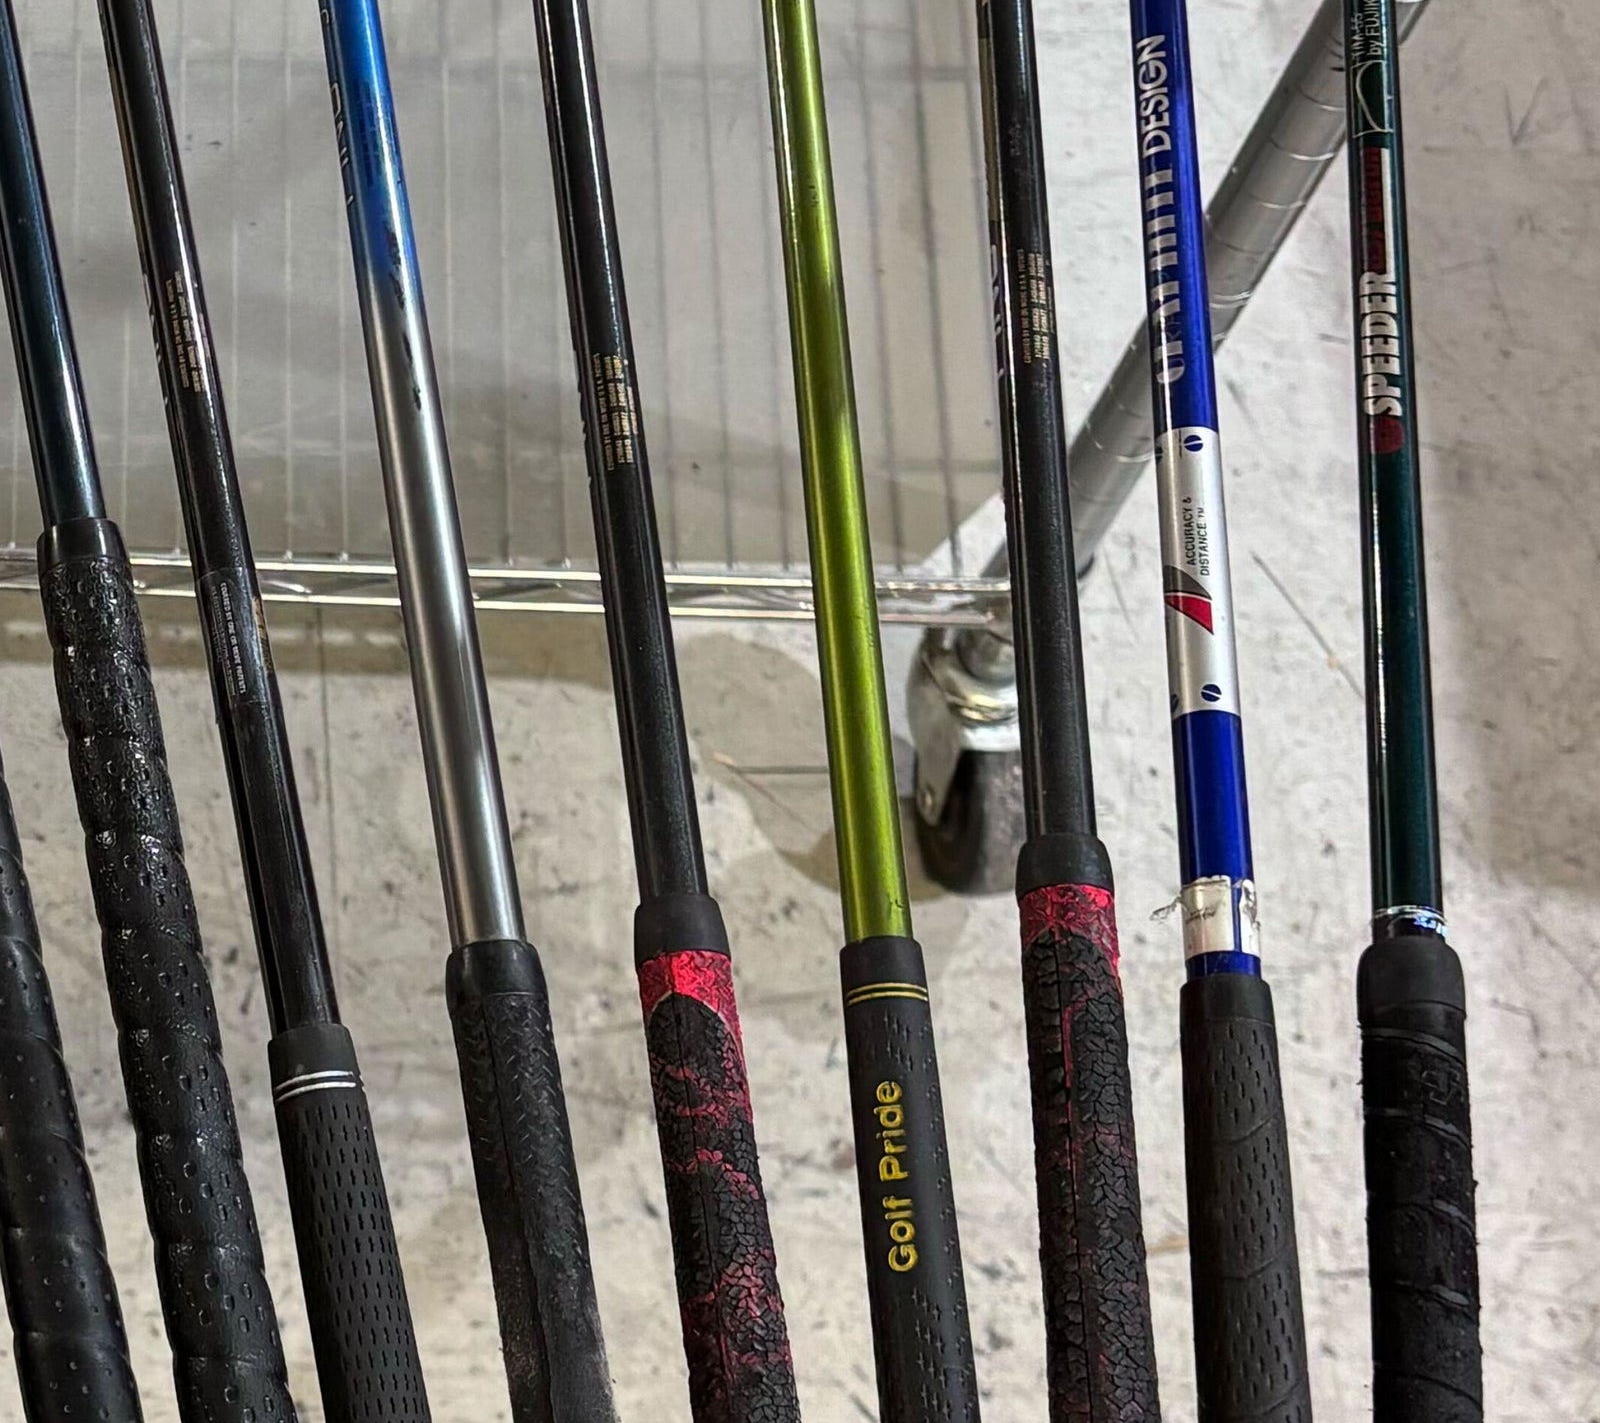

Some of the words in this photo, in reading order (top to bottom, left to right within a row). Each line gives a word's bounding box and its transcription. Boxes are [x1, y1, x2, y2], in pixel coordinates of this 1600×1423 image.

[1366, 37, 1384, 56] by
[1136, 34, 1171, 158] DESIGN
[1357, 270, 1403, 417] SPEEDER
[1182, 507, 1196, 566] ACCURACY
[1196, 522, 1210, 576] DISTANCE
[876, 1080, 909, 1182] Pride
[881, 1196, 919, 1272] Golf
